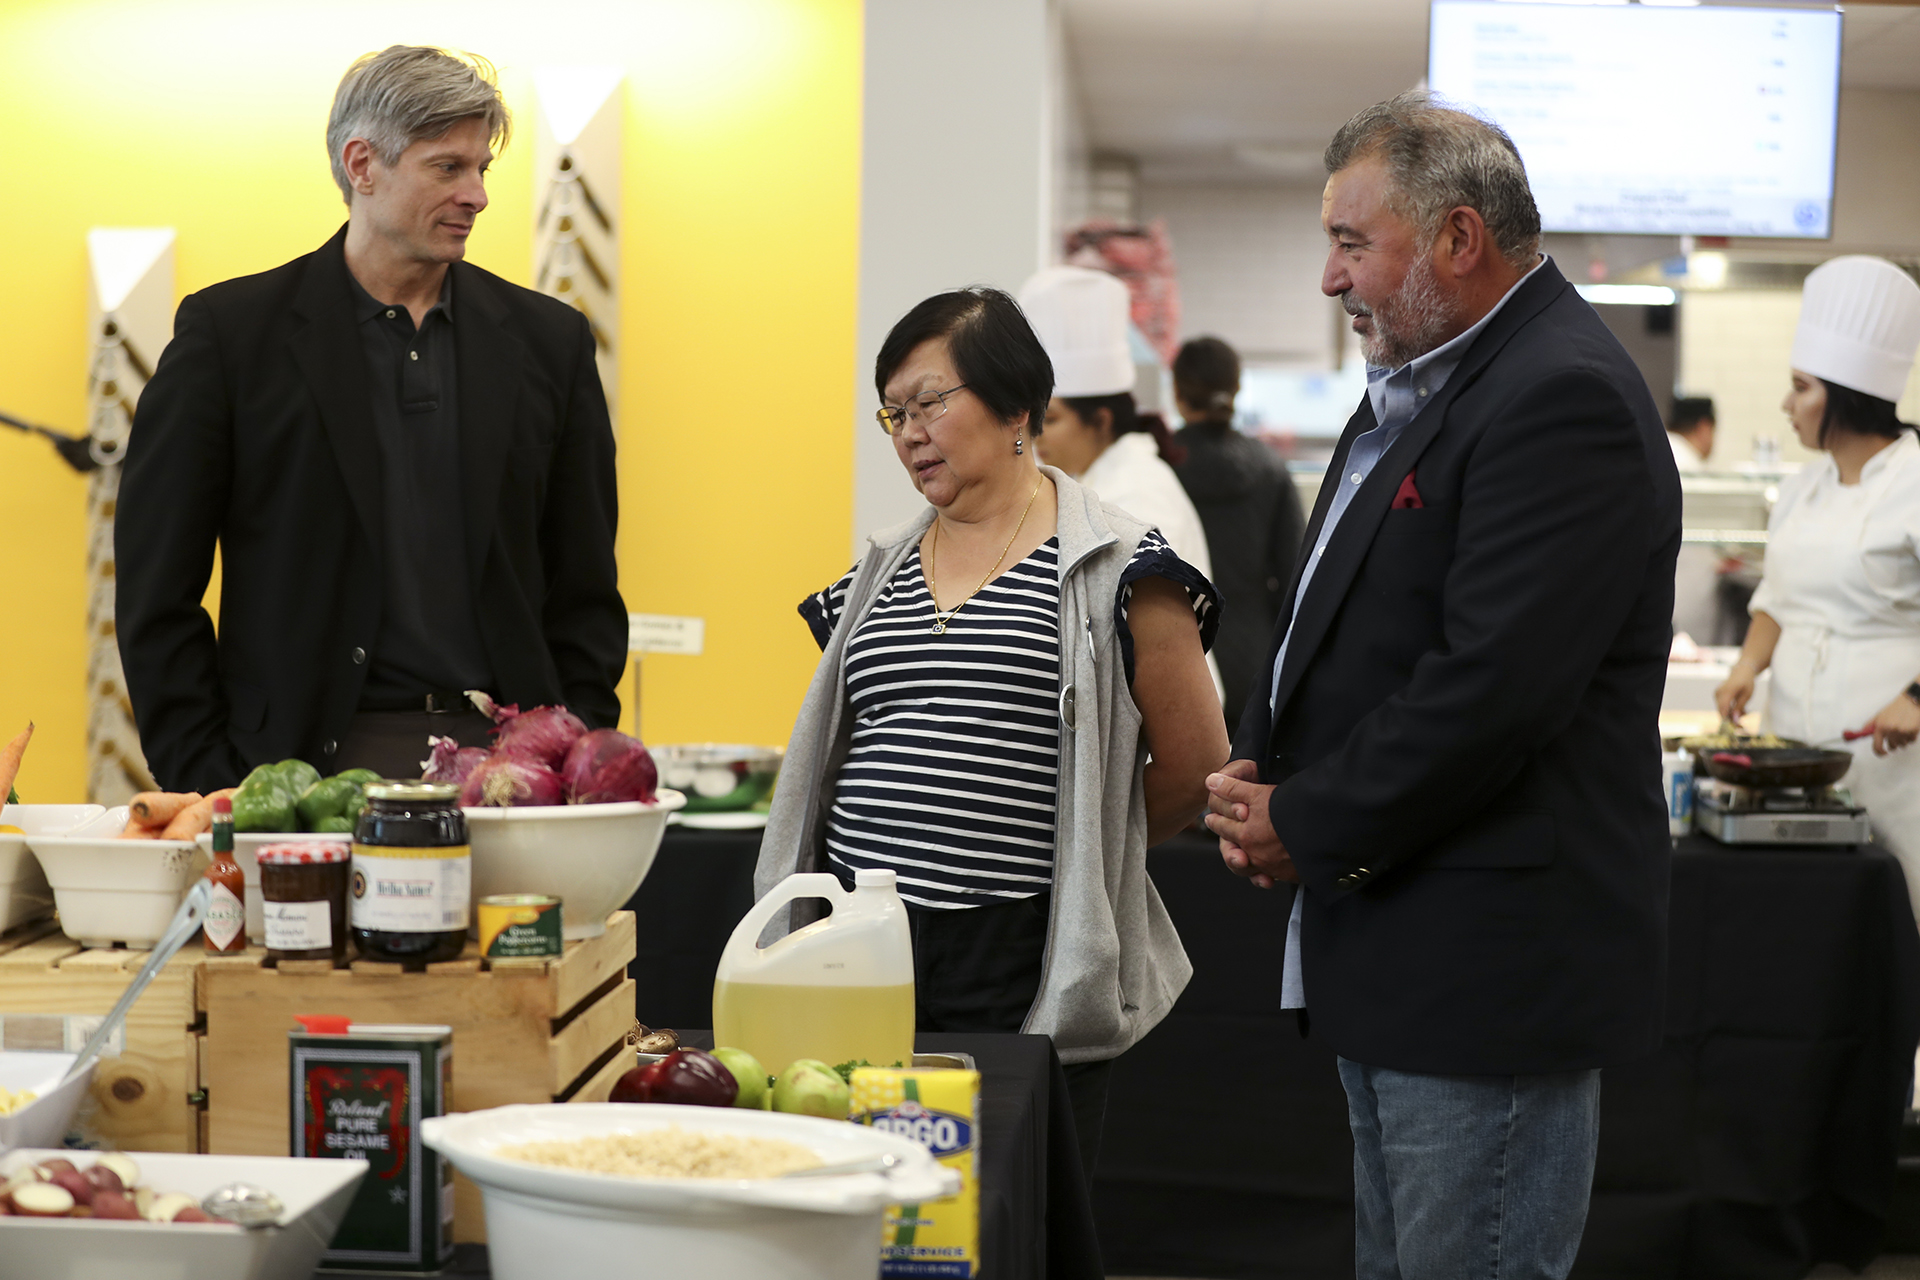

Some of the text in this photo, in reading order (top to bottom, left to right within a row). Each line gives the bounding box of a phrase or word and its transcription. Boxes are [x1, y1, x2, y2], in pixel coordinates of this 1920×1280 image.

[508, 925, 537, 938] Green
[498, 934, 547, 948] Peppercorns
[326, 1098, 390, 1118] Roland
[336, 1117, 379, 1133] PURE
[324, 1132, 389, 1150] SESAME
